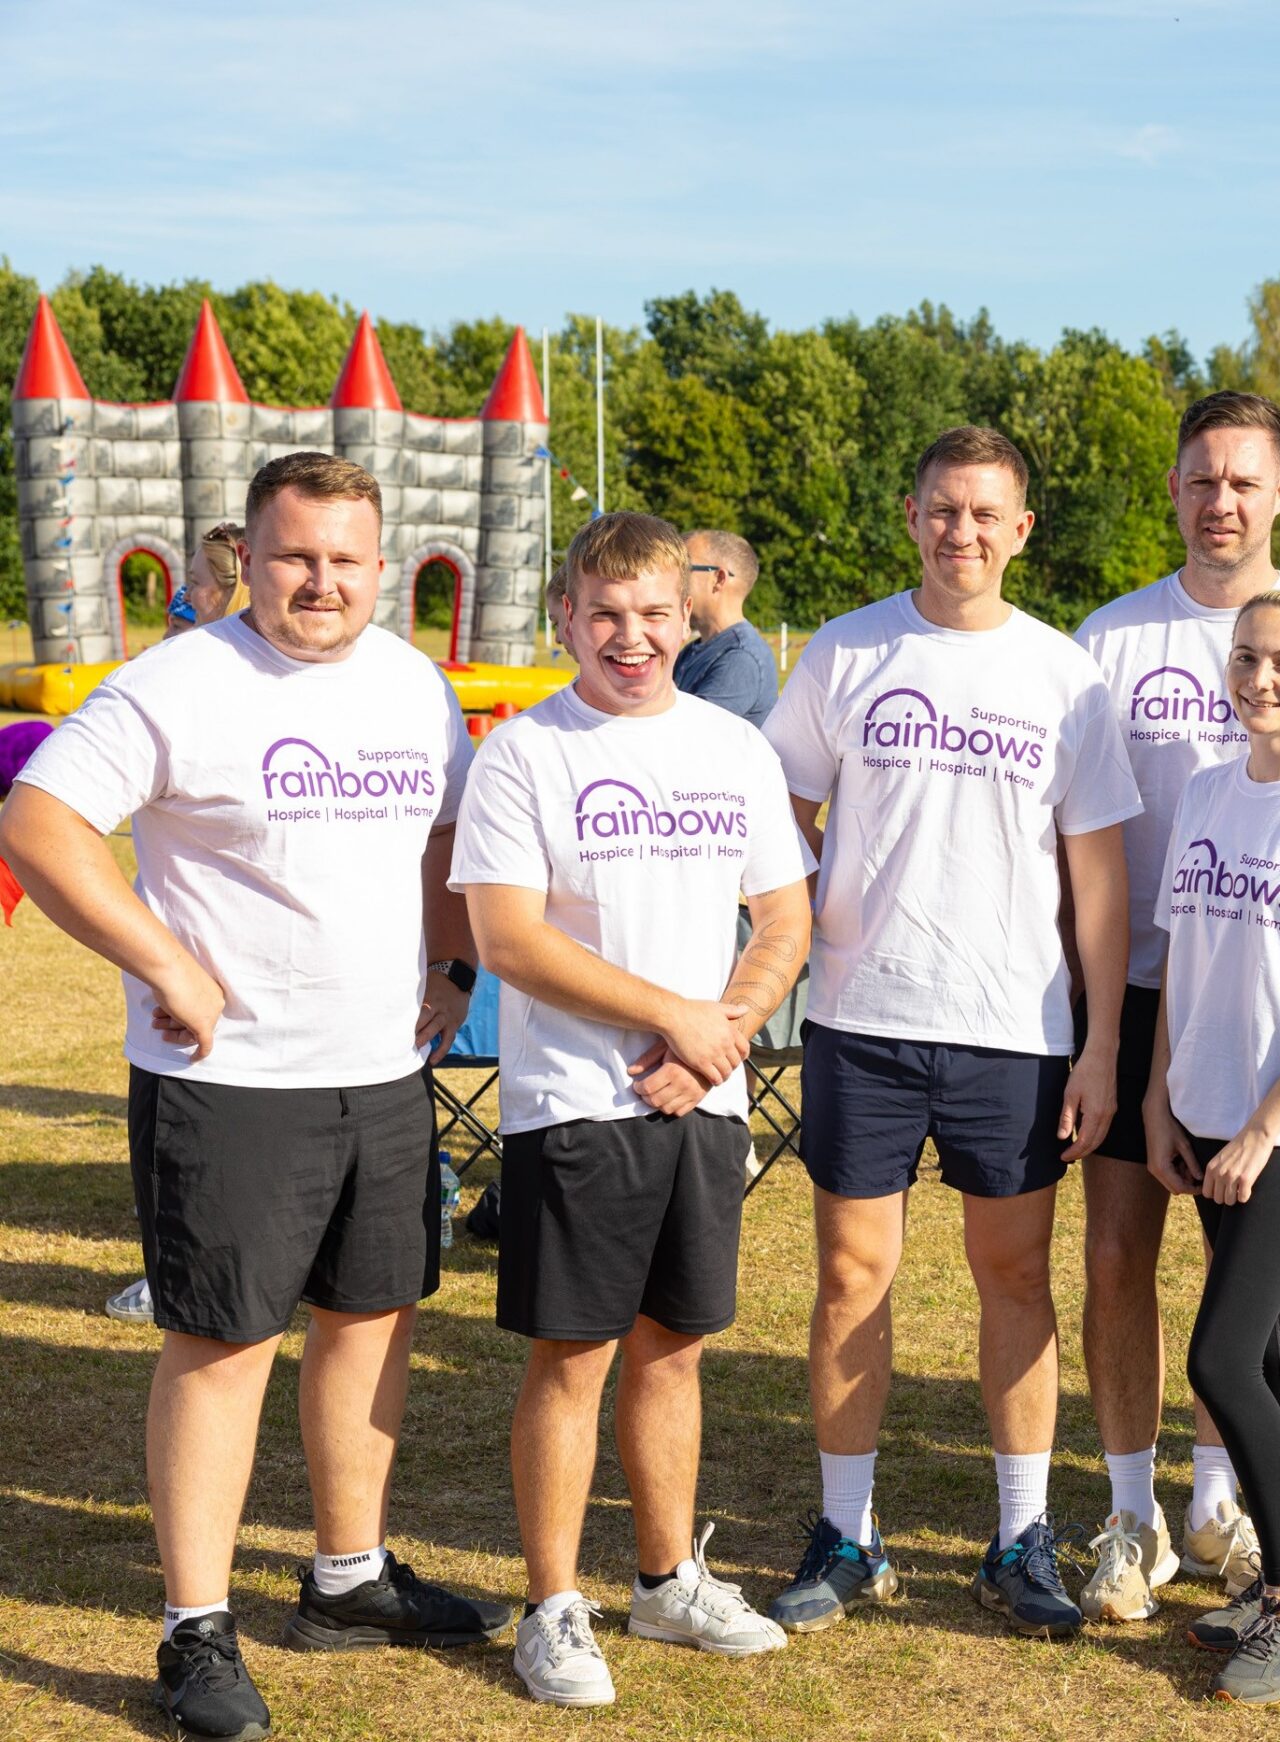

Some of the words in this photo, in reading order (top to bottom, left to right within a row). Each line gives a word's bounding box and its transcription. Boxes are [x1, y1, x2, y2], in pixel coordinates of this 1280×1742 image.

[970, 706, 1047, 739] Supporting
[862, 711, 1044, 769] rainbows
[1129, 728, 1180, 743] Hospice
[1197, 730, 1250, 745] Hospita
[357, 749, 428, 763] Supporting
[262, 761, 435, 799] rainbows
[862, 755, 912, 771] Hospice
[929, 758, 987, 778] Hospital
[1003, 769, 1035, 790] Home
[672, 790, 746, 807] Supporting
[267, 806, 321, 822] Hospice
[334, 806, 388, 820] Hospital
[404, 804, 434, 817] Home
[575, 800, 748, 841] rainbows
[579, 846, 634, 863] Hospice
[331, 1553, 371, 1568] PUMA
